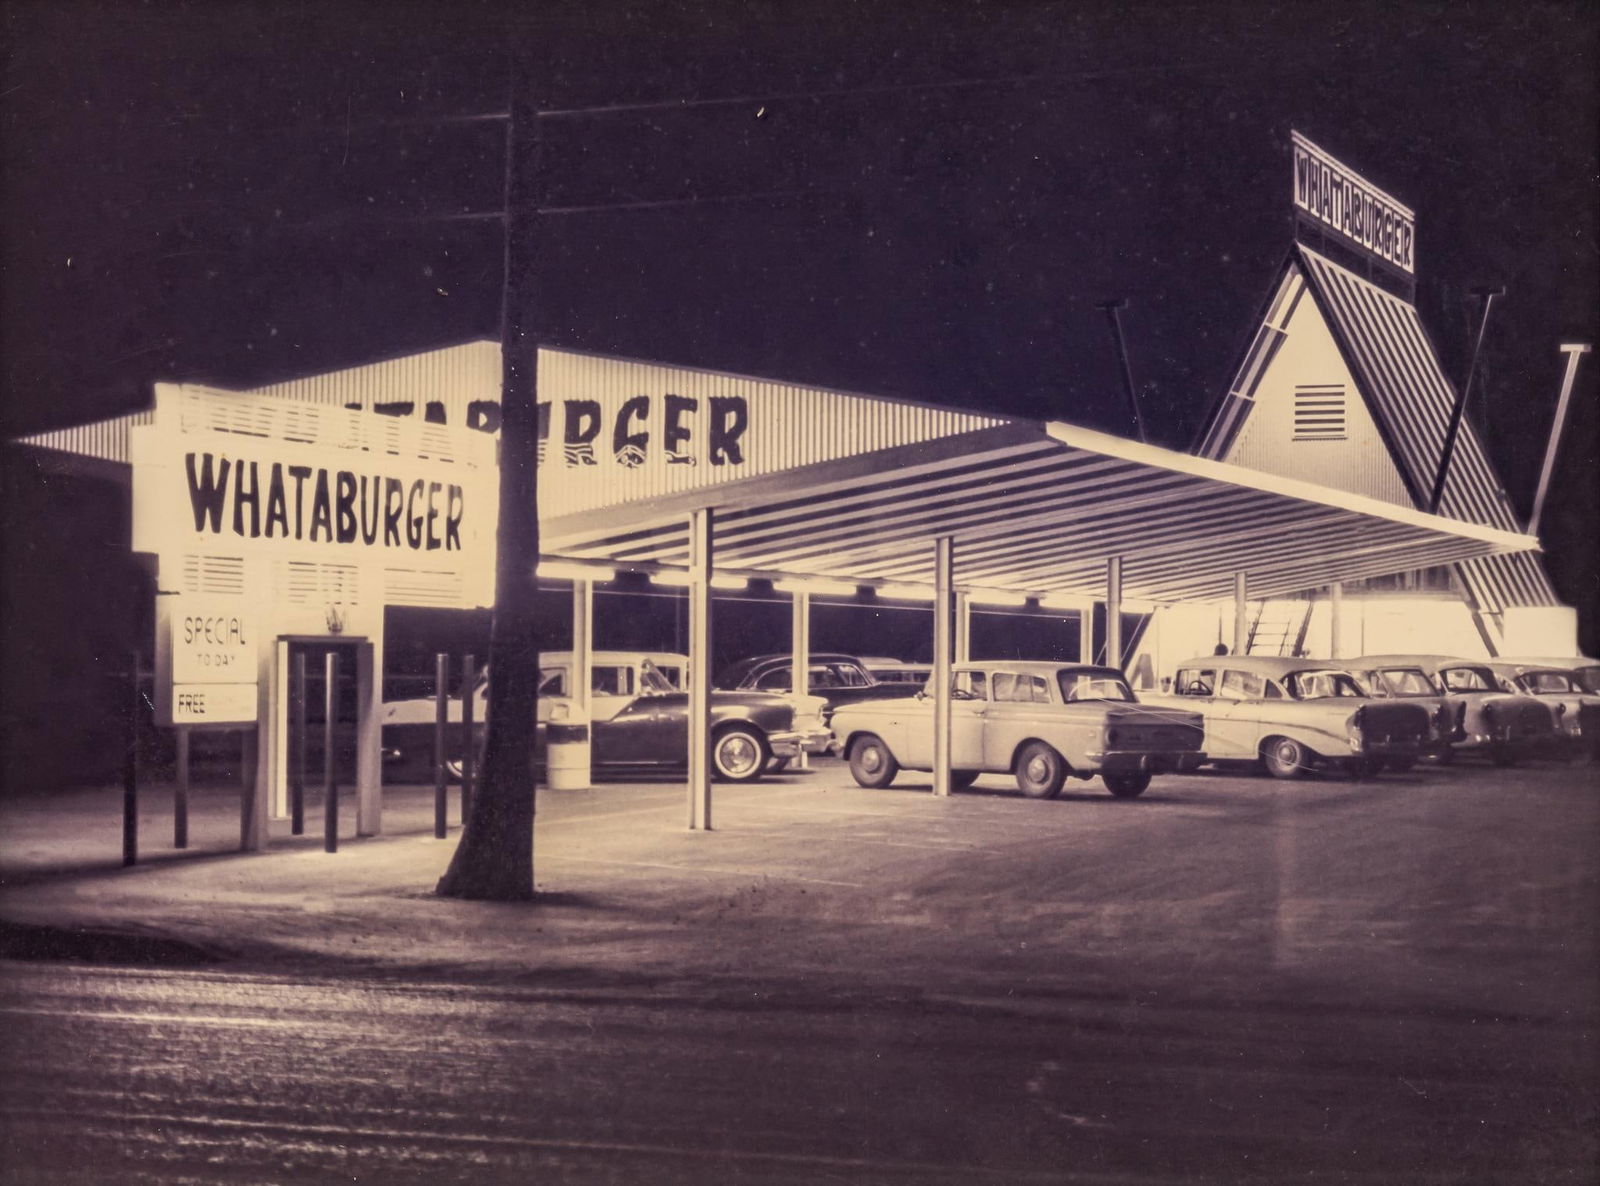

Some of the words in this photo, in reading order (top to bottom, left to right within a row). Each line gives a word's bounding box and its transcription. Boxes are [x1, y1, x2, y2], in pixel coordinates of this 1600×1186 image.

[1296, 151, 1412, 267] WHATABURGER
[185, 451, 464, 551] WHATABURGER
[184, 616, 246, 645] SPECIAL
[178, 693, 206, 714] FREE
